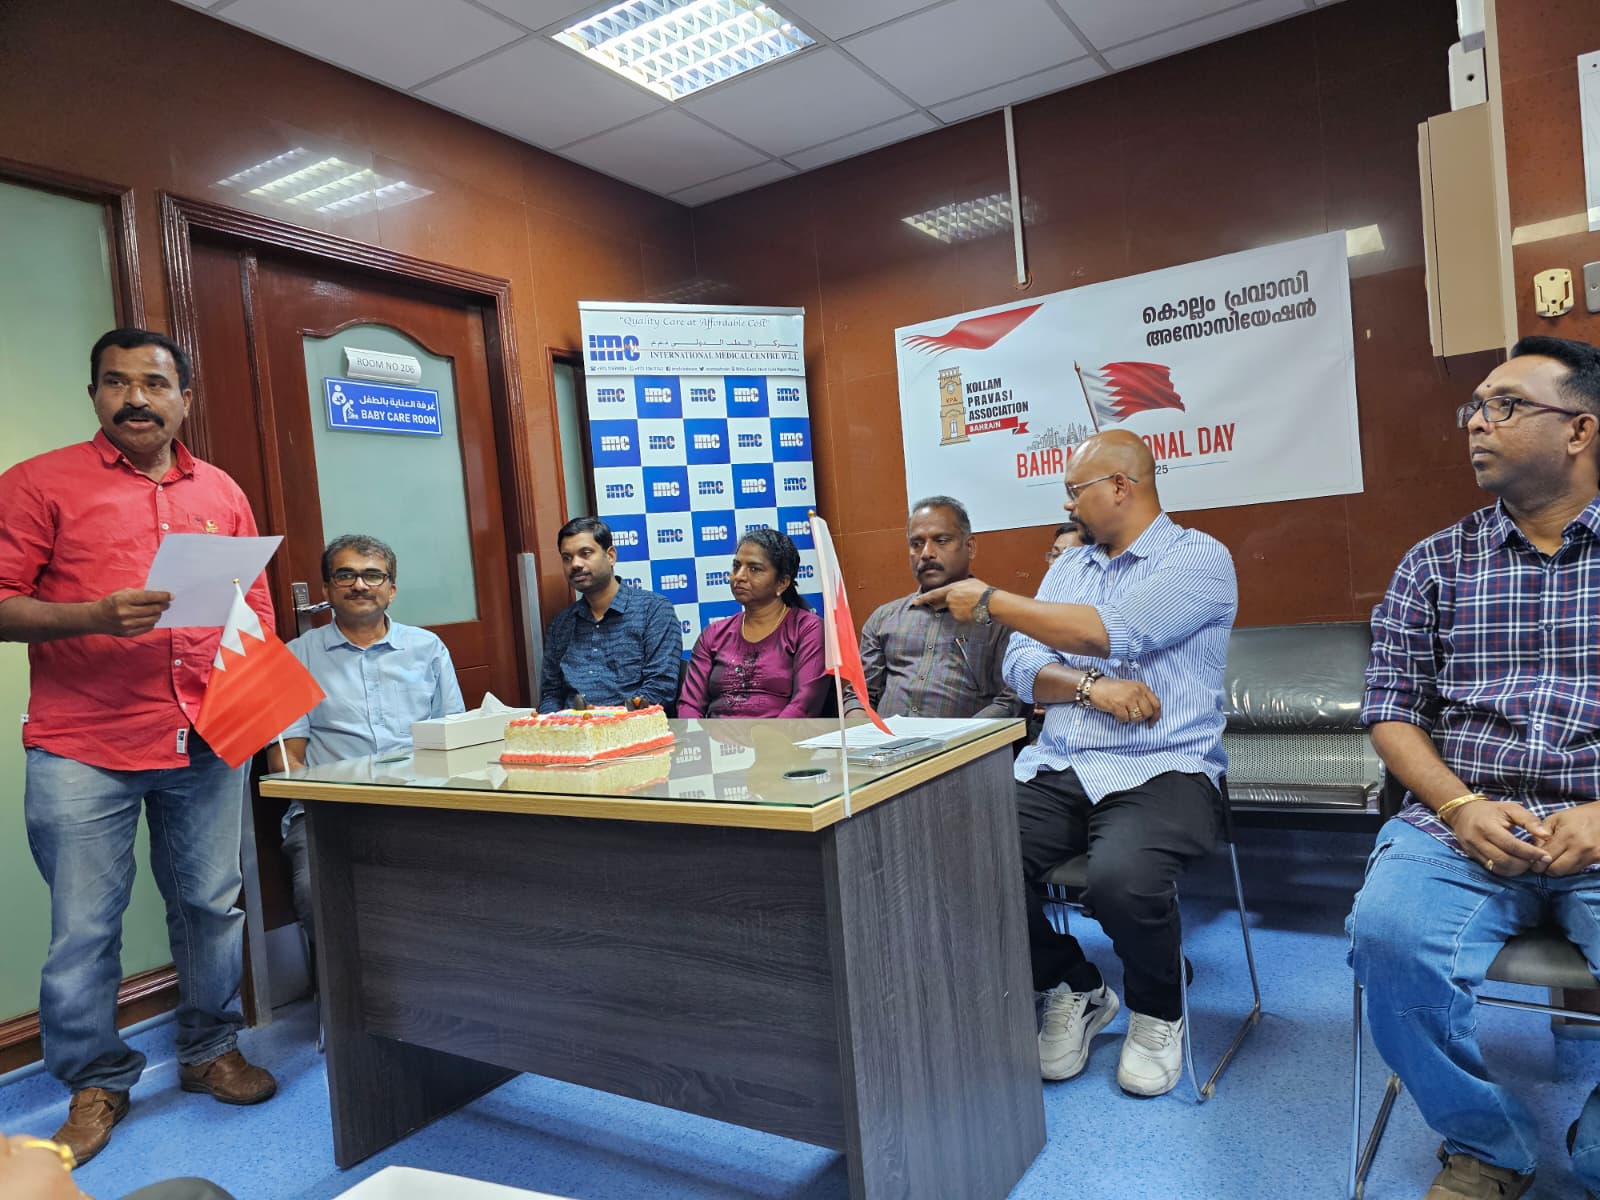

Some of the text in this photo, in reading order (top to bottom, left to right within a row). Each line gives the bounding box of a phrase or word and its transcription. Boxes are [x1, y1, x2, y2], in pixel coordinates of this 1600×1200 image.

[1143, 270, 1309, 325] കൊല്ലം പ്രവാസി
[663, 318, 684, 326] Care
[357, 357, 384, 369] ROOM
[386, 361, 399, 371] NO
[650, 351, 714, 360] INTERNATIONAL
[715, 352, 750, 360] MEDICAL
[750, 352, 781, 360] CENTRE
[966, 377, 1002, 394] KOLLAM
[359, 395, 436, 412] غرفة العناية بالطفل
[967, 389, 1013, 408] PRAVASI
[361, 409, 437, 425] BABY CARE ROOM
[968, 401, 1029, 421] ASSOCIATION
[969, 420, 1001, 433] BAHRAIN
[1197, 422, 1235, 455] DAY
